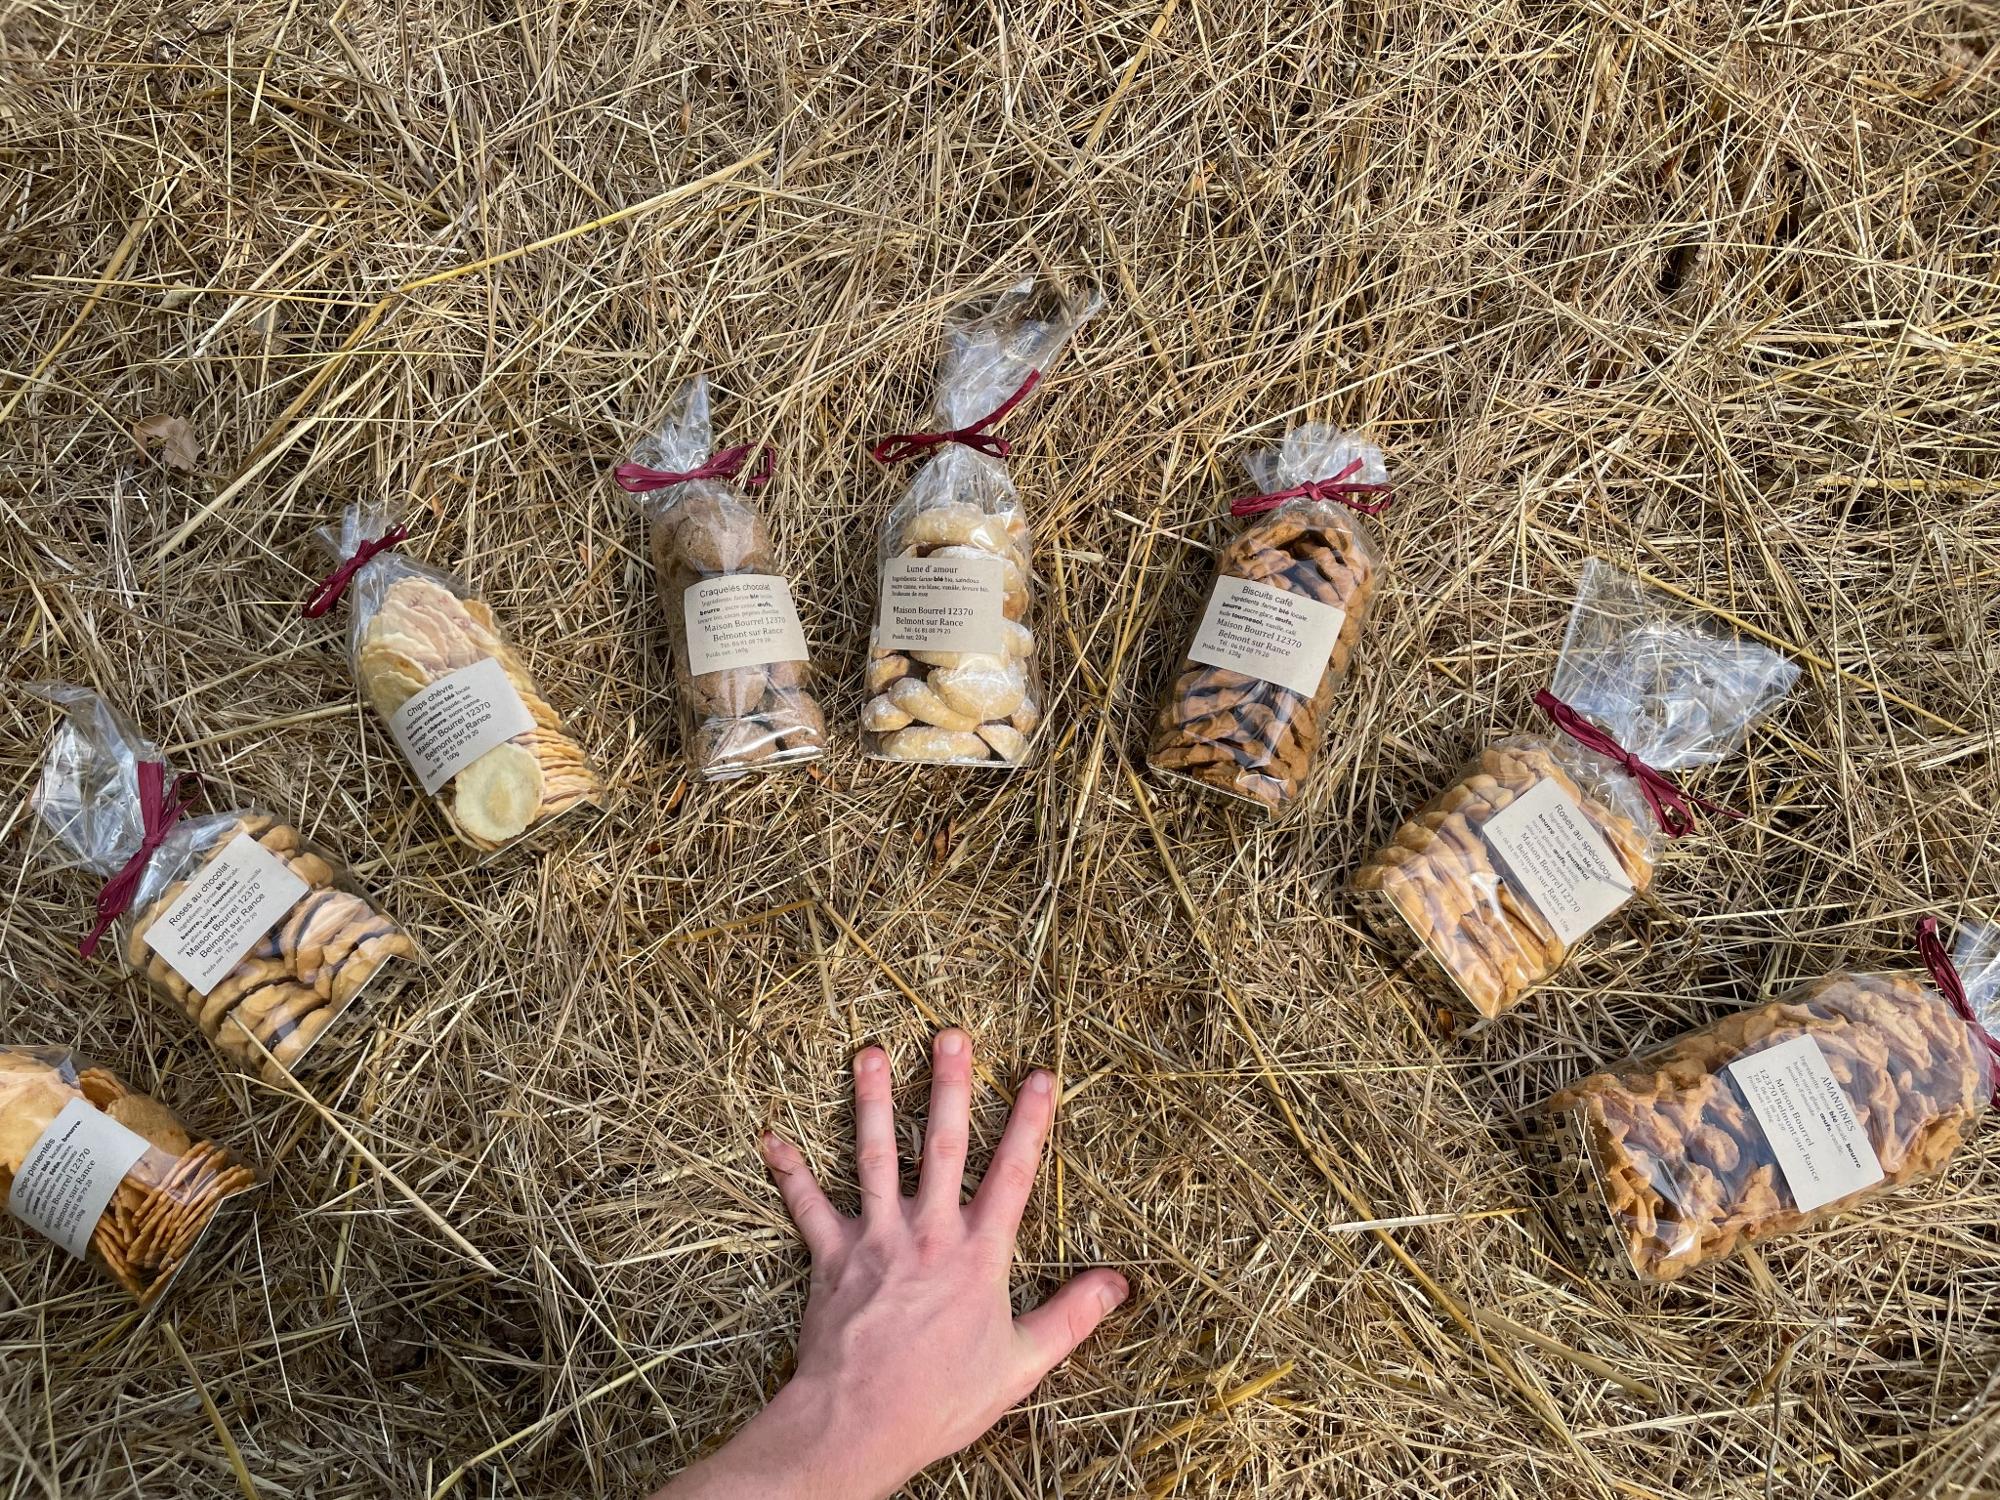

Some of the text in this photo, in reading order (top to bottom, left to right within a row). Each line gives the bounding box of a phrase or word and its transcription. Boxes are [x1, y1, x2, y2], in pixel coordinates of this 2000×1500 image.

[699, 582, 770, 598] Craquelés chocolat
[893, 606, 916, 614] Maison
[1241, 585, 1294, 607] Biscuits café
[704, 616, 785, 632] Maison Bourrel 12370
[713, 629, 747, 641] Belmont
[763, 627, 783, 635] Rance
[895, 616, 924, 625] Belmont
[939, 618, 963, 626] Rance
[1216, 617, 1302, 649] Maison Bourrel 12370
[1217, 628, 1290, 656] Belmont sur Rance
[406, 683, 454, 717] Chips chèvre
[414, 700, 491, 755] Maison Bourrel 12370
[424, 712, 492, 761] Belmont sur Rance
[1553, 803, 1611, 880] Roses au spéculoos
[168, 860, 230, 927] Roses au chocolat
[1515, 843, 1565, 912] Belmont sur Rance
[1519, 832, 1581, 913] Maison Bourrel 12370
[179, 919, 202, 940] beurre,
[185, 880, 261, 958] Maison Bourrel 12370
[198, 892, 265, 959] Belmont sur Rance
[202, 913, 219, 930] œufs,
[1758, 1068, 1819, 1182] 12370 Belmont sur Rance
[1774, 1077, 1814, 1147] Maison Bourrel
[1819, 1074, 1856, 1133] AMANDINES
[1827, 1110, 1839, 1123] blé
[16, 1175, 30, 1199] Chips
[27, 1137, 56, 1177] pimentés
[51, 1173, 73, 1205] Bourrel
[68, 1146, 91, 1175] 12370
[53, 1197, 72, 1230] Belmont
[69, 1184, 80, 1199] sur
[75, 1158, 96, 1185] Rance
